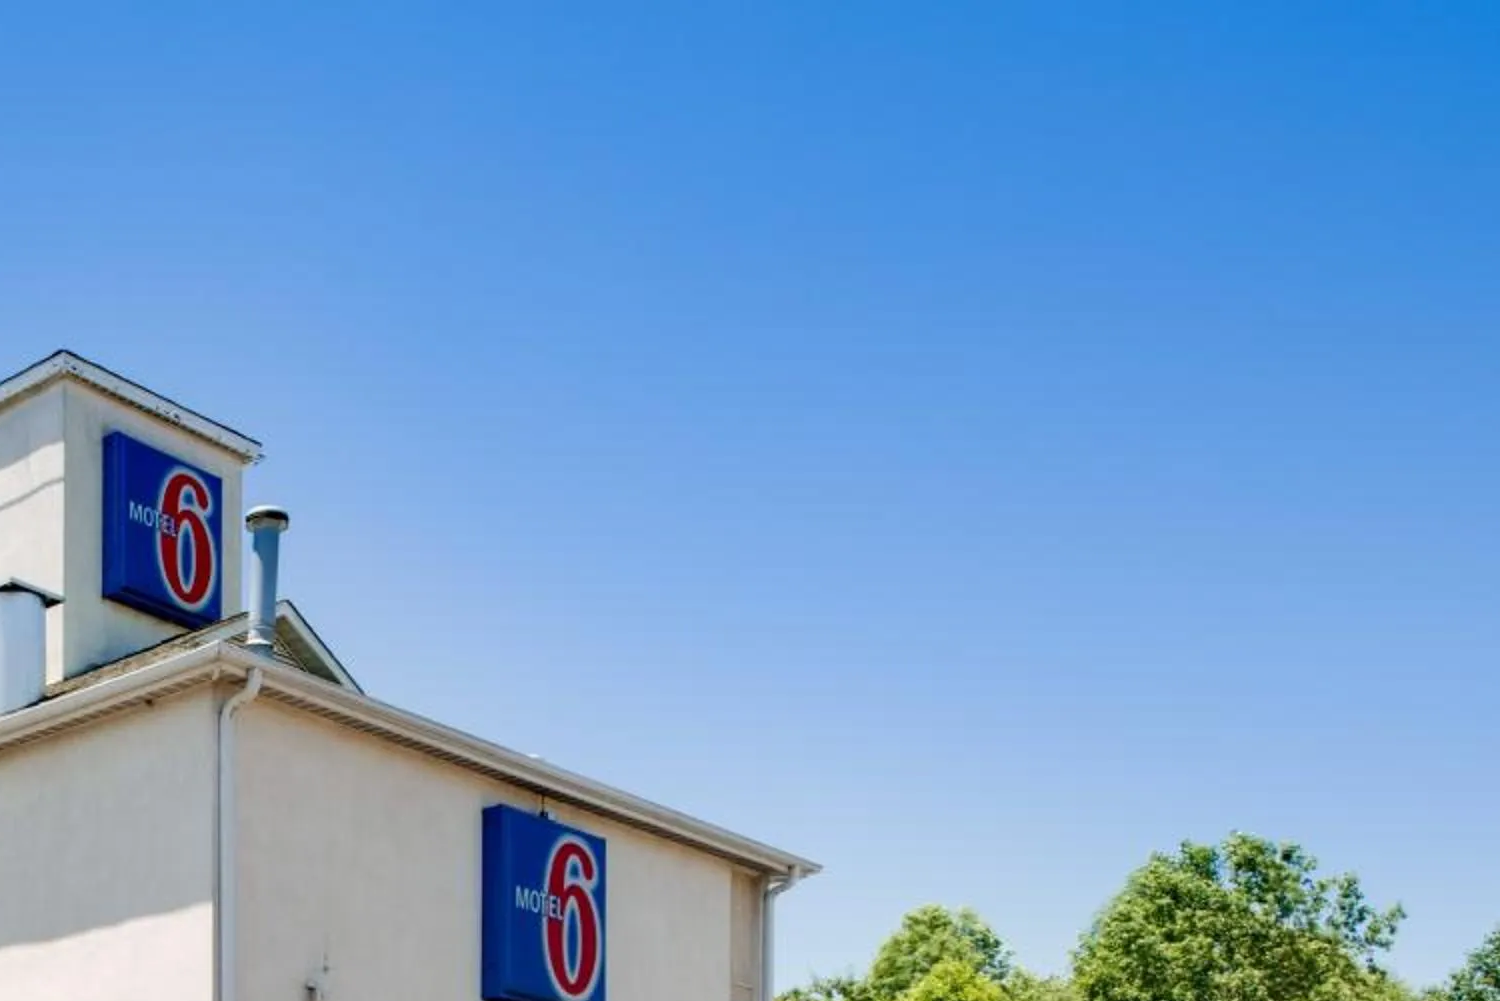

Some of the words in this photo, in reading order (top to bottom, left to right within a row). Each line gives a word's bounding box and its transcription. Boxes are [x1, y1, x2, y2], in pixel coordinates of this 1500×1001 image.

[129, 500, 179, 538] MOTEL
[158, 467, 214, 611] 6
[515, 885, 565, 921] MOTEL
